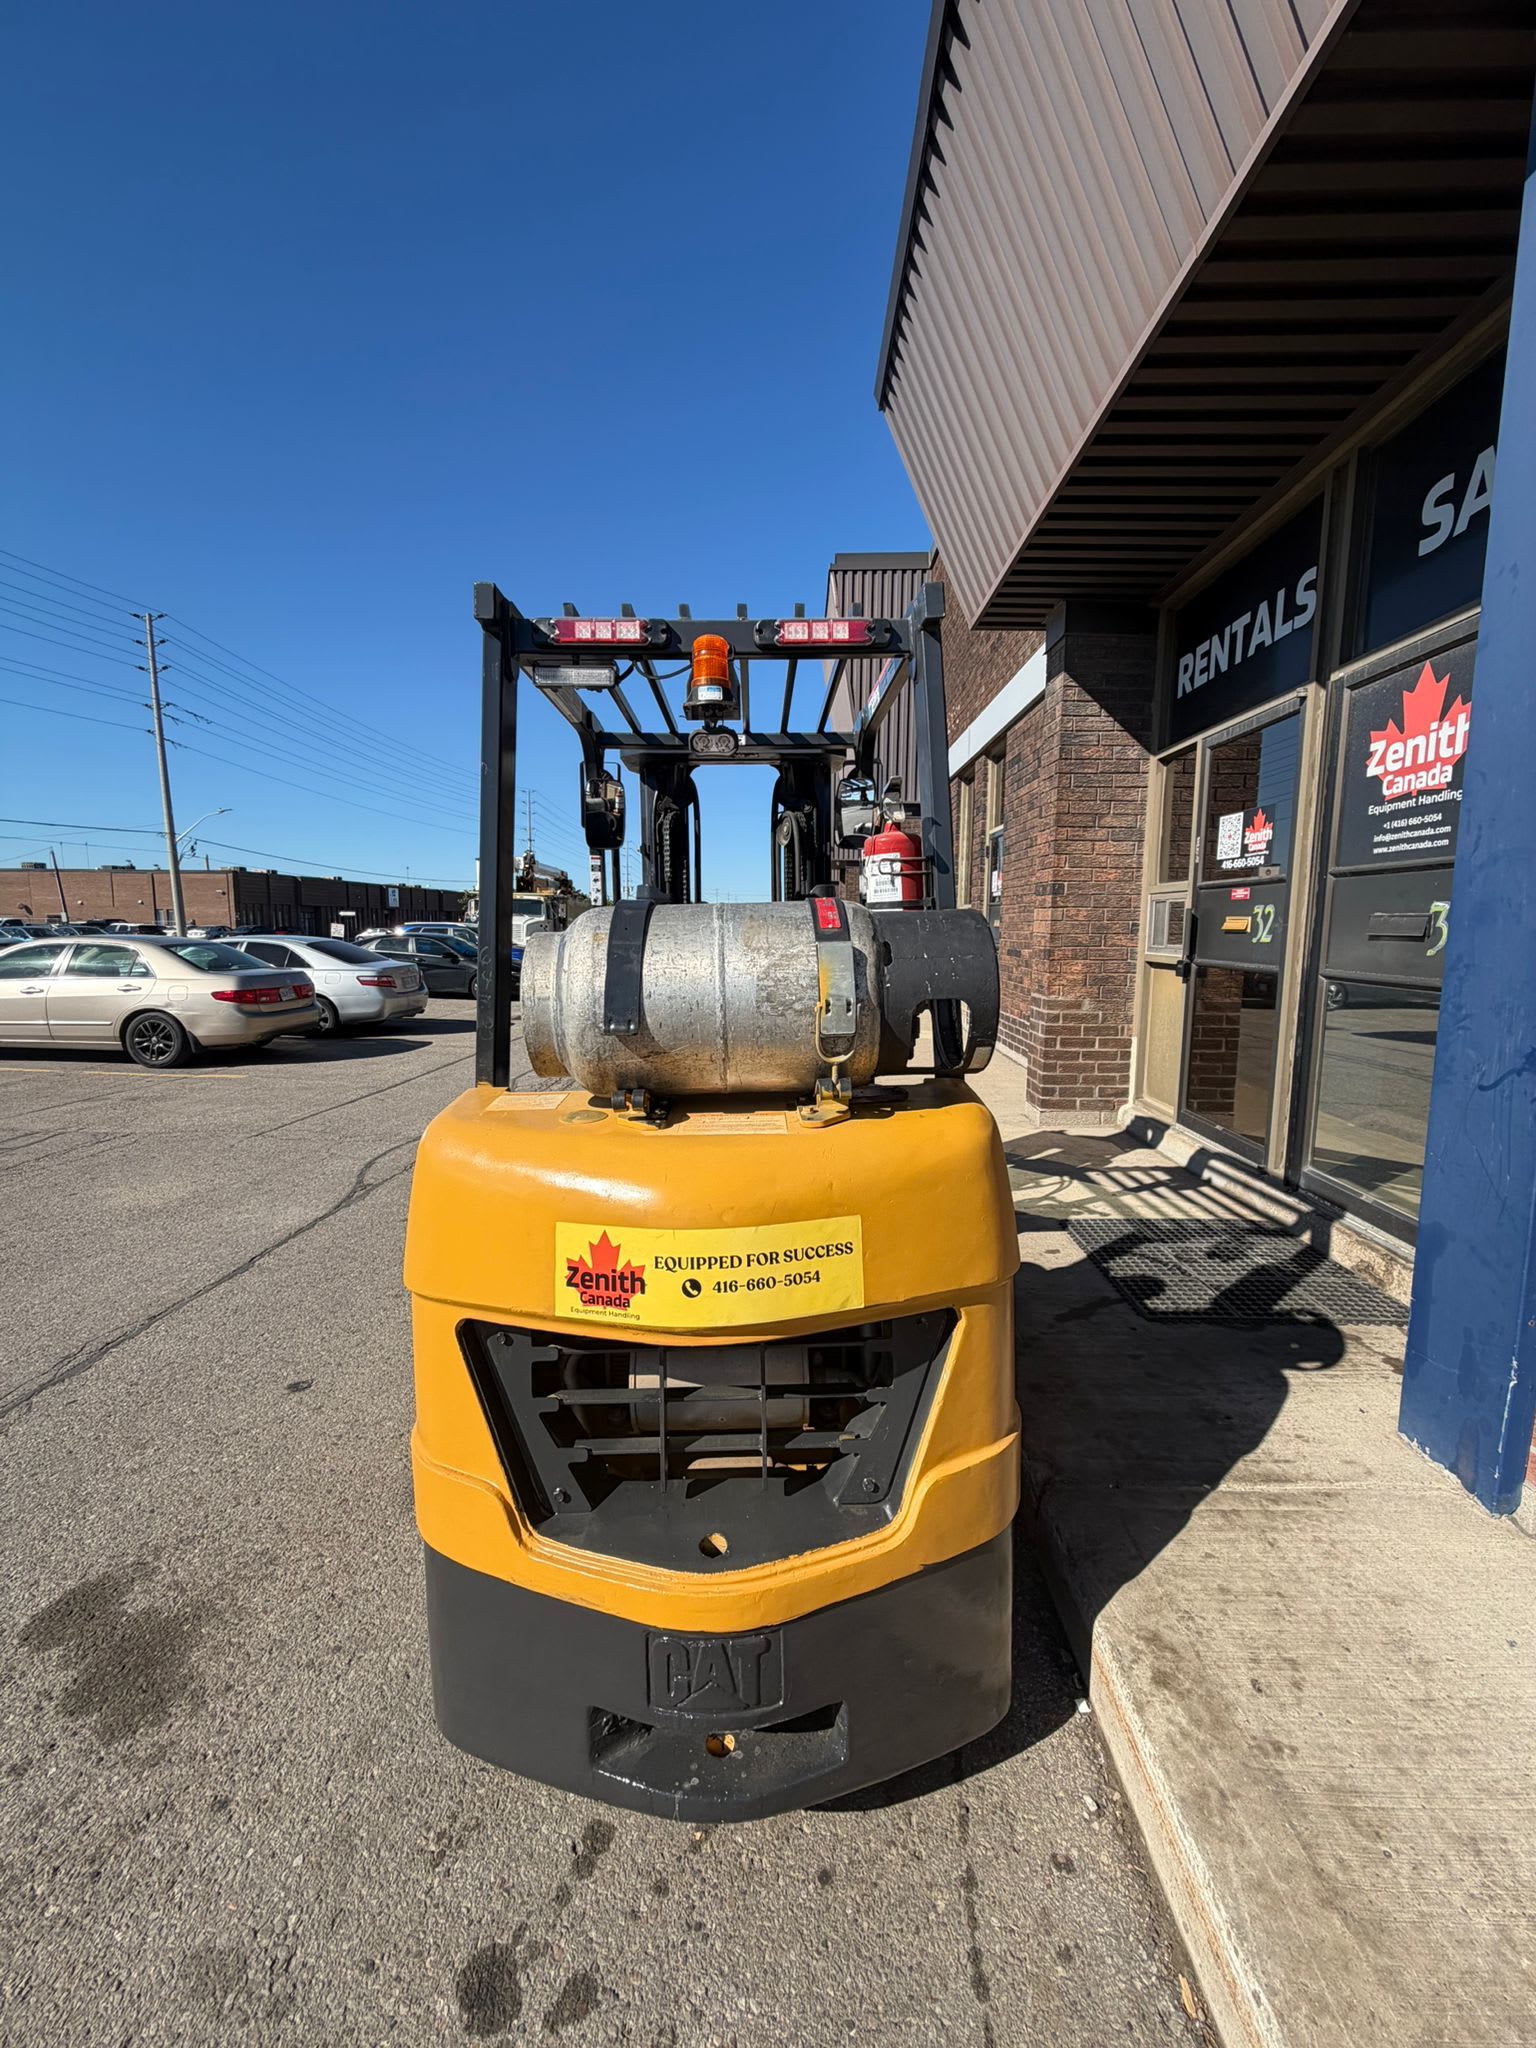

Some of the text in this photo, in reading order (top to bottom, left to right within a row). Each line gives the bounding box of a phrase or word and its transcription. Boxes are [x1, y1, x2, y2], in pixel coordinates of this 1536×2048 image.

[1418, 445, 1497, 557] SA
[1177, 566, 1318, 699] RENTALS
[1382, 761, 1453, 796] Canada
[1368, 789, 1463, 815] Equipment Handling
[1373, 825, 1452, 842] info@zenithcanada.com
[1391, 818, 1408, 829] (416)
[1408, 813, 1443, 826] 660-5054
[1244, 827, 1273, 845] Zenith
[1373, 839, 1449, 854] www.zenithcanada.com
[1221, 855, 1265, 869] 416-660-5054
[1251, 904, 1276, 944] 32
[1425, 901, 1451, 956] 3
[654, 1241, 854, 1273] EQUIPPED FOR SUCCESS
[566, 1266, 646, 1295] Zenith
[712, 1270, 821, 1293] 416-660-5054
[579, 1291, 631, 1308] Canada
[570, 1306, 640, 1320] Equipment Handling
[652, 1636, 772, 1707] CAT
